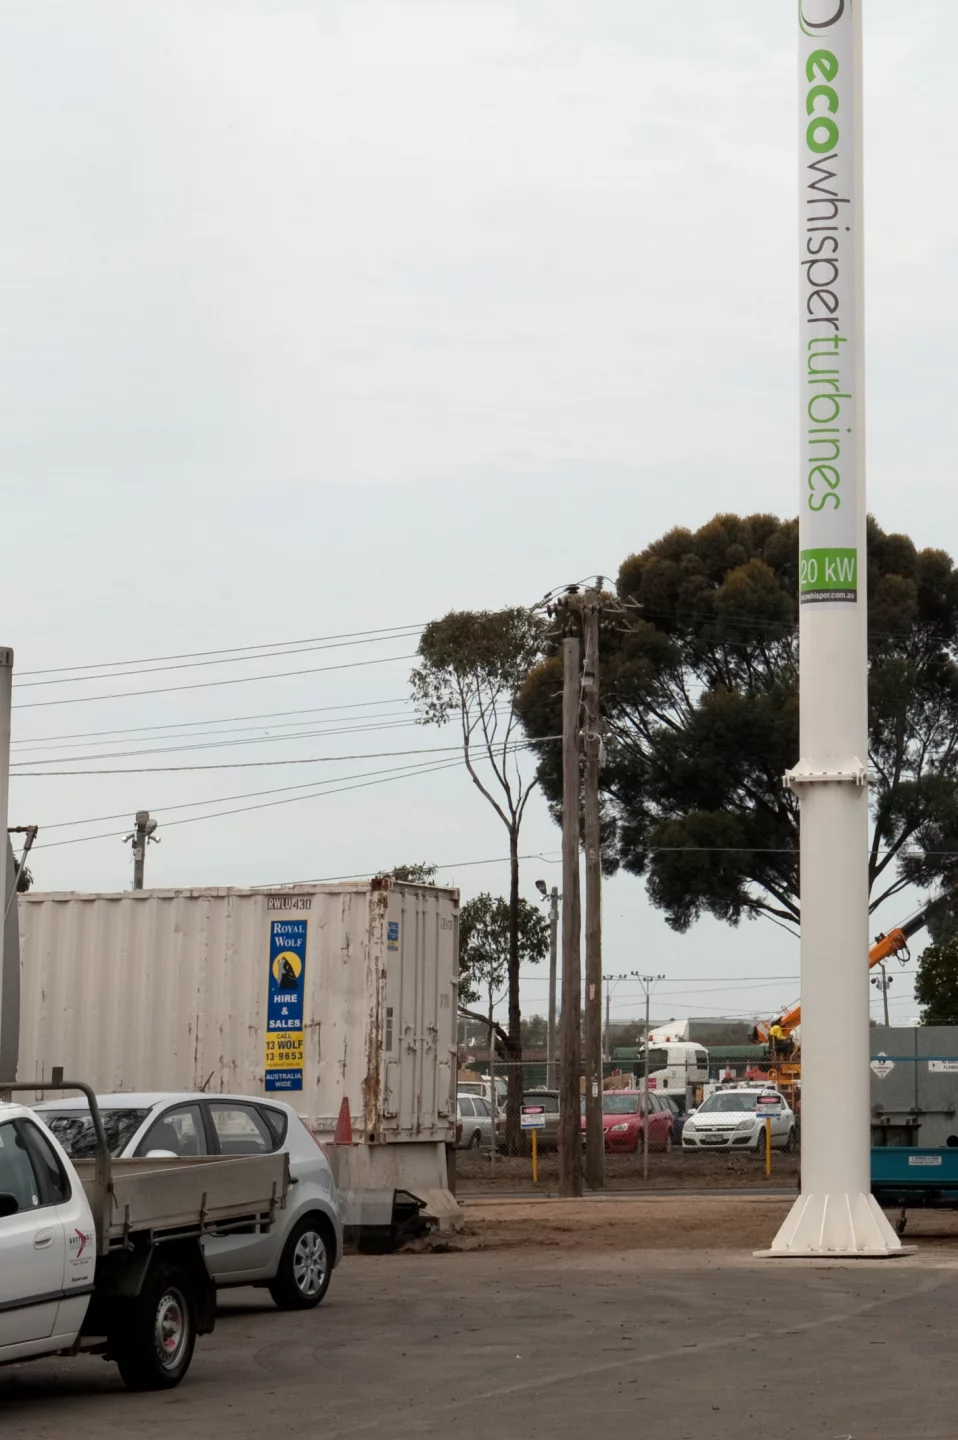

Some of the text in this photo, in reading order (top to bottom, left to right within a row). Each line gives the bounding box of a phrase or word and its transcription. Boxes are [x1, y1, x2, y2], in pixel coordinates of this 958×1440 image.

[801, 556, 855, 584] 20 kW
[267, 898, 292, 910] RWLU
[273, 923, 304, 934] ROYAL
[275, 936, 303, 947] WOLF
[273, 994, 298, 1003] HIRE
[281, 1007, 289, 1015] &
[269, 1019, 300, 1028] SALES
[266, 1040, 303, 1050] 13 WOLF
